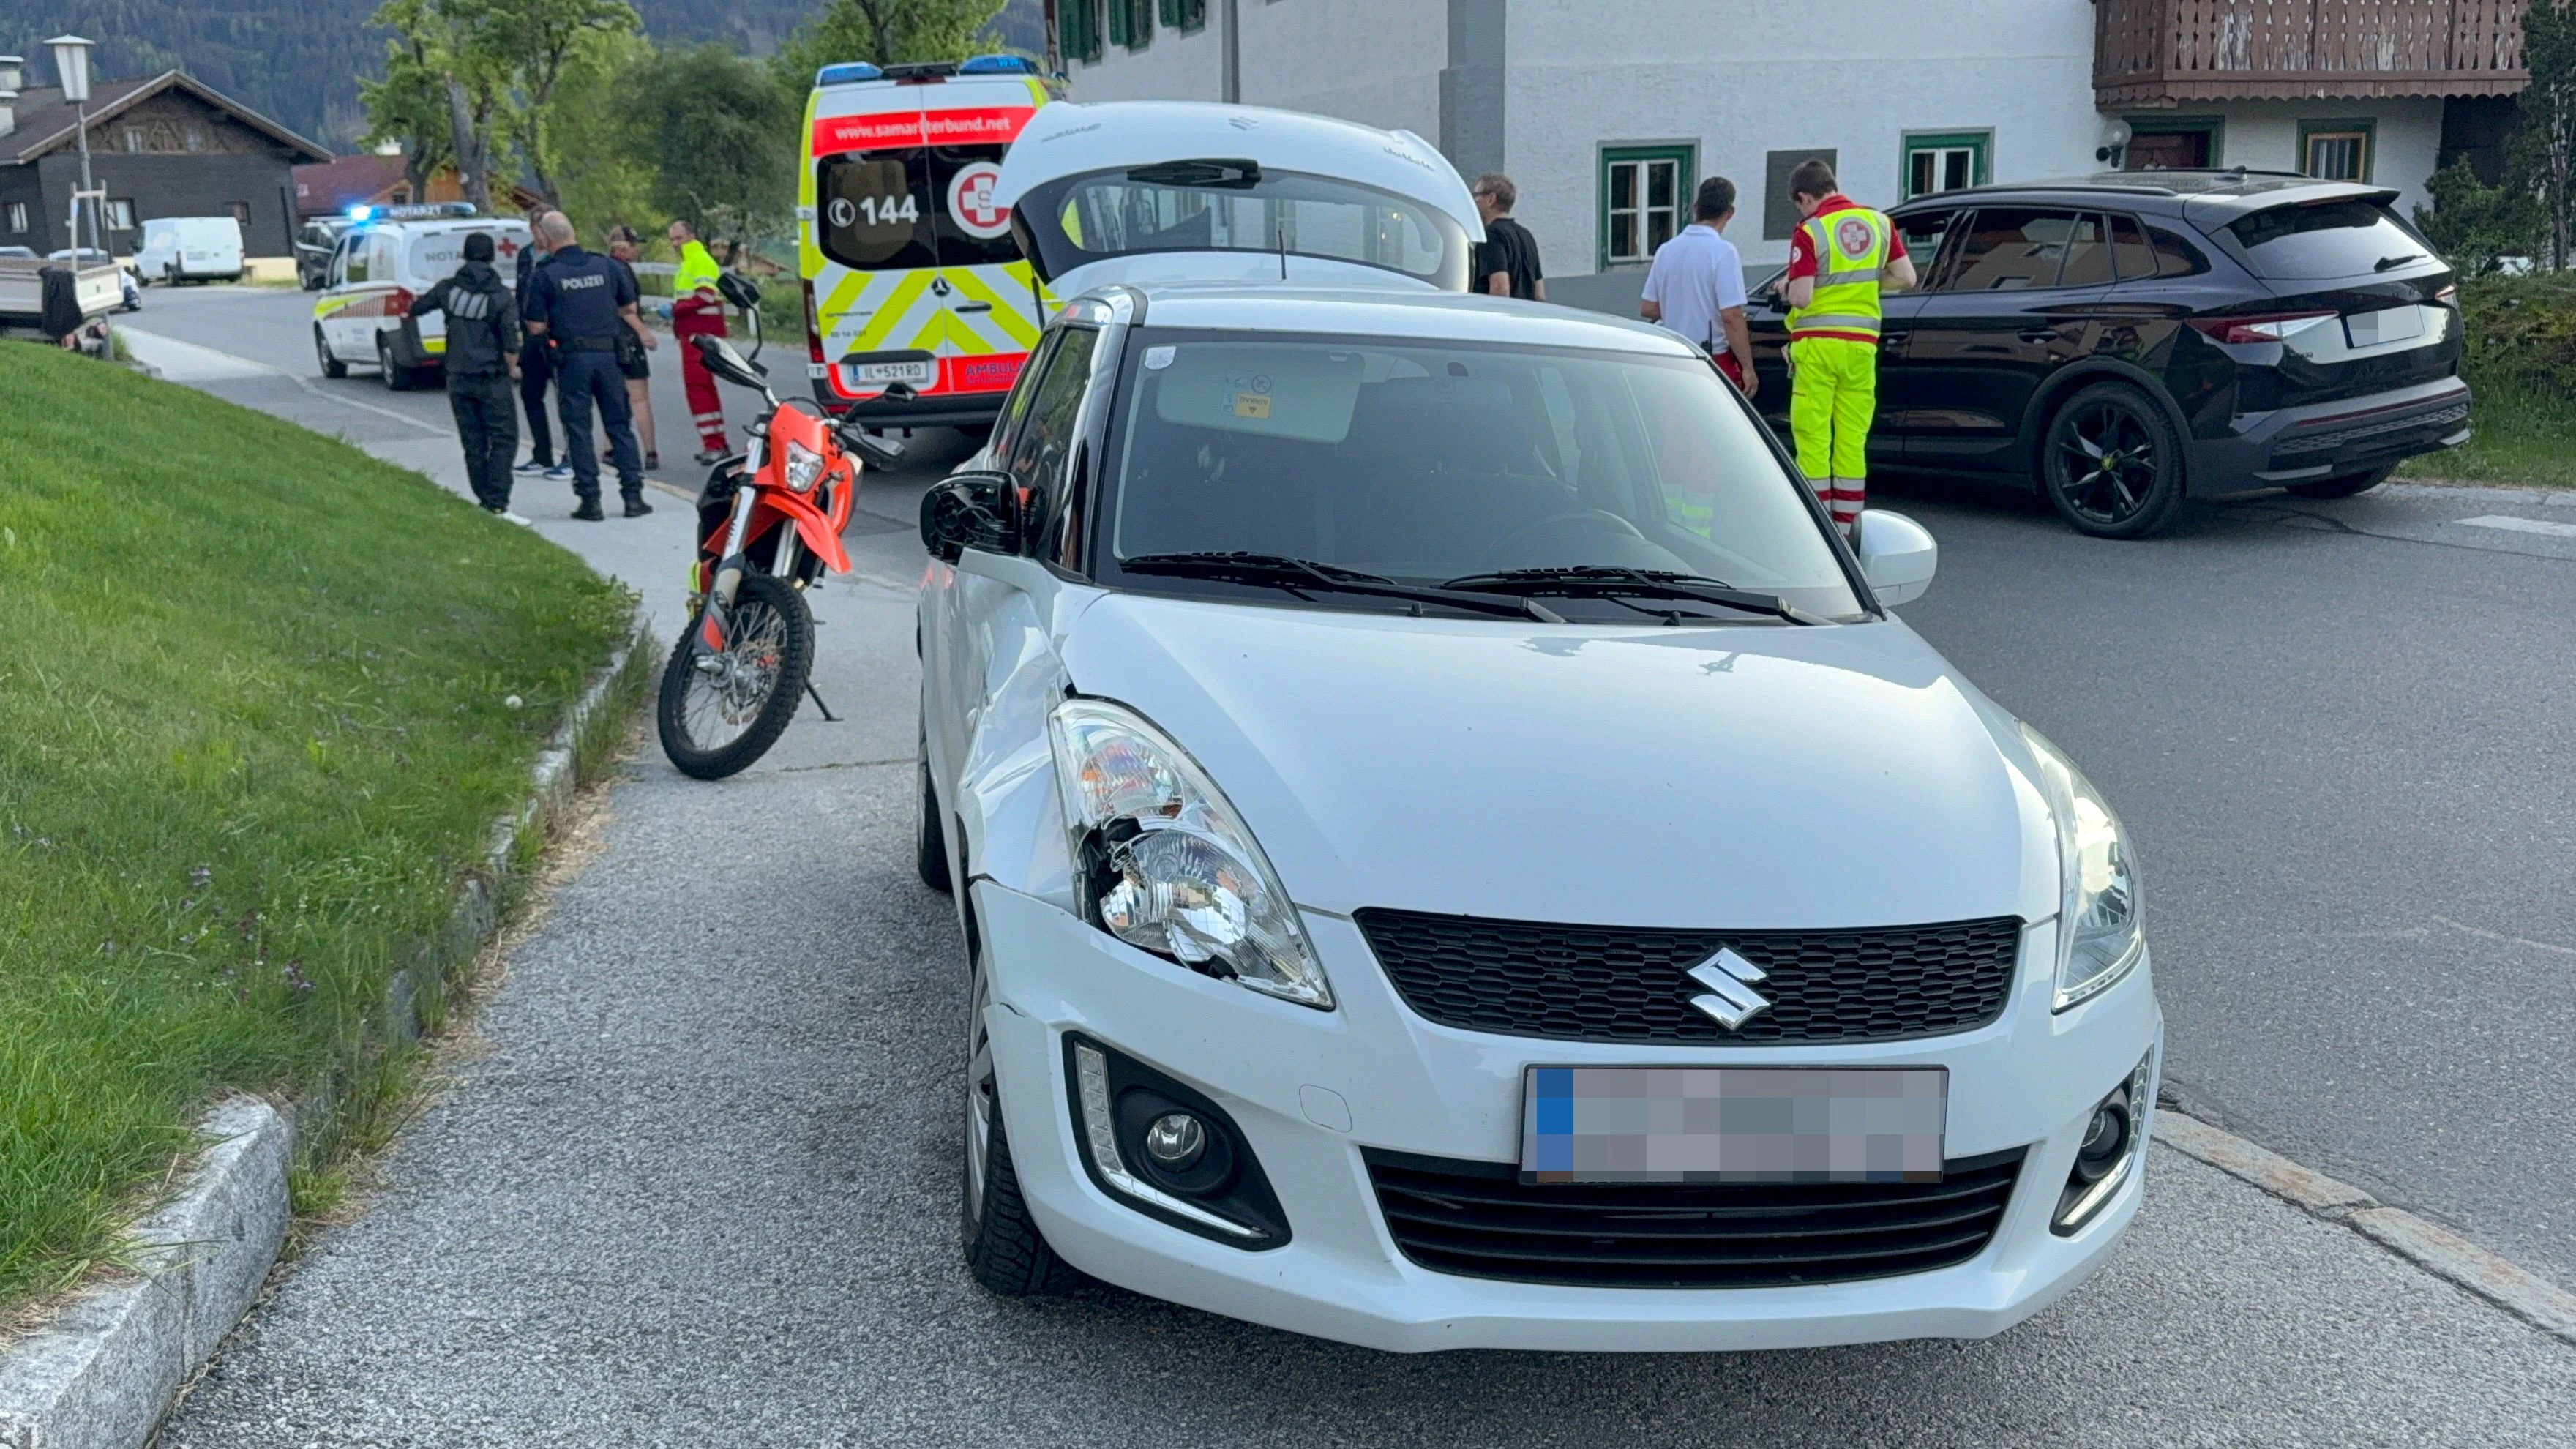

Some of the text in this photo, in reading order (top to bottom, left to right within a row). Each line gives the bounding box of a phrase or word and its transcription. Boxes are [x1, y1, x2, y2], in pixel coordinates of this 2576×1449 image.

[835, 117, 1010, 140] www.samariterbund.net
[859, 193, 919, 226] 144
[560, 274, 605, 291] POLIZEI
